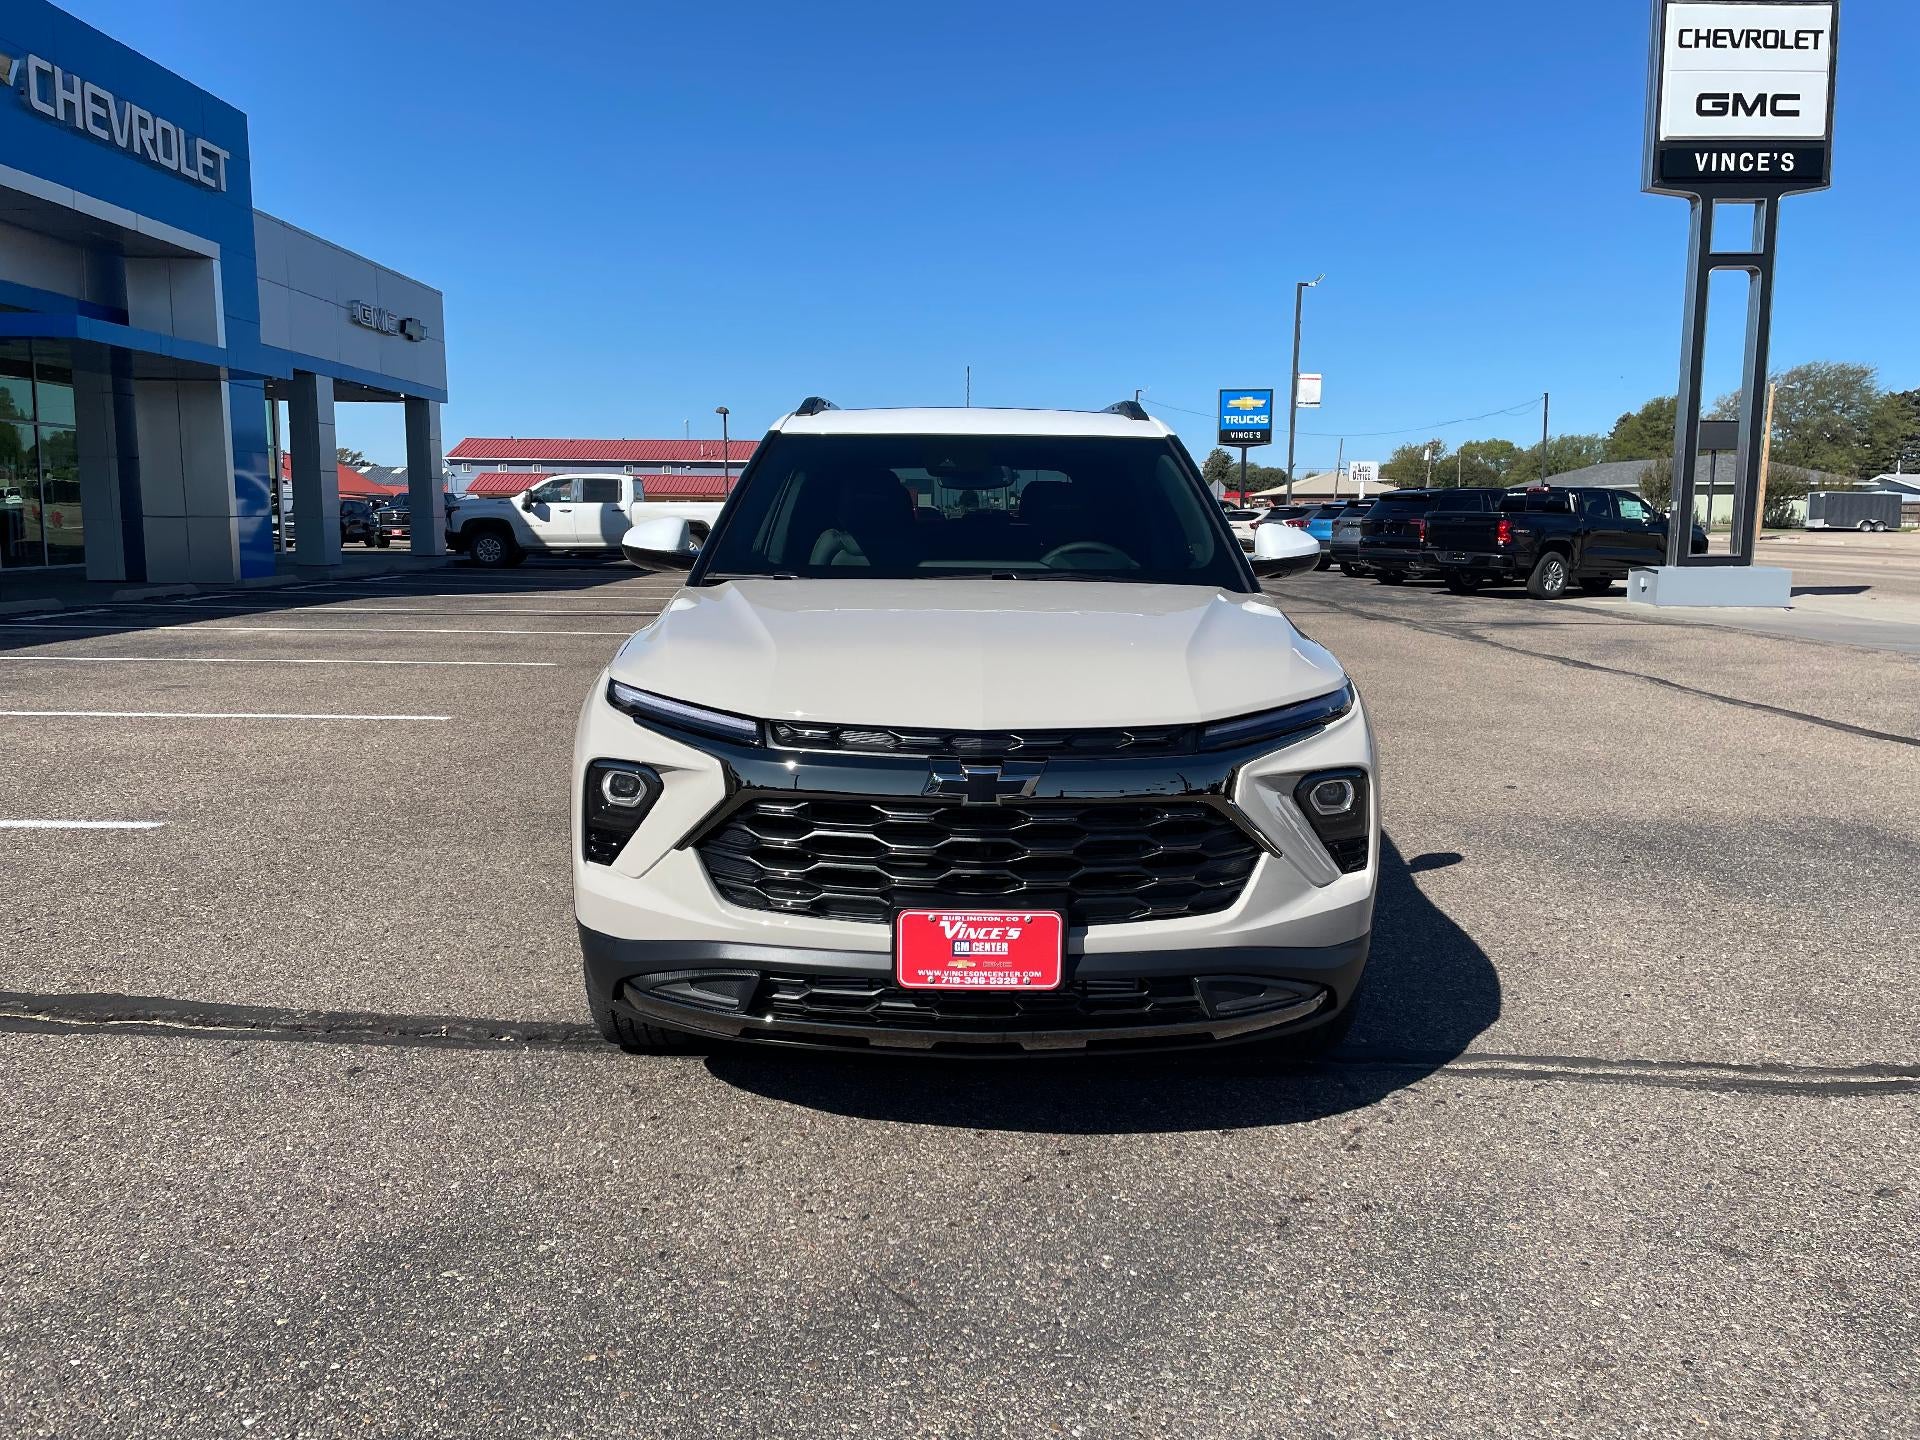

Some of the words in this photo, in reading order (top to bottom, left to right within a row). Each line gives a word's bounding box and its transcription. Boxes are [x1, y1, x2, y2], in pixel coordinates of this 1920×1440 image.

[1678, 28, 1825, 50] CHEVROLET
[1695, 92, 1801, 117] GMC
[26, 53, 230, 192] CHEVROLET
[1694, 152, 1795, 172] VINCE'S
[354, 301, 399, 336] GMC
[1223, 415, 1269, 424] TRUCKS
[1230, 431, 1261, 439] VINCE'S
[953, 941, 970, 953] GM
[972, 941, 1009, 953] CENTER
